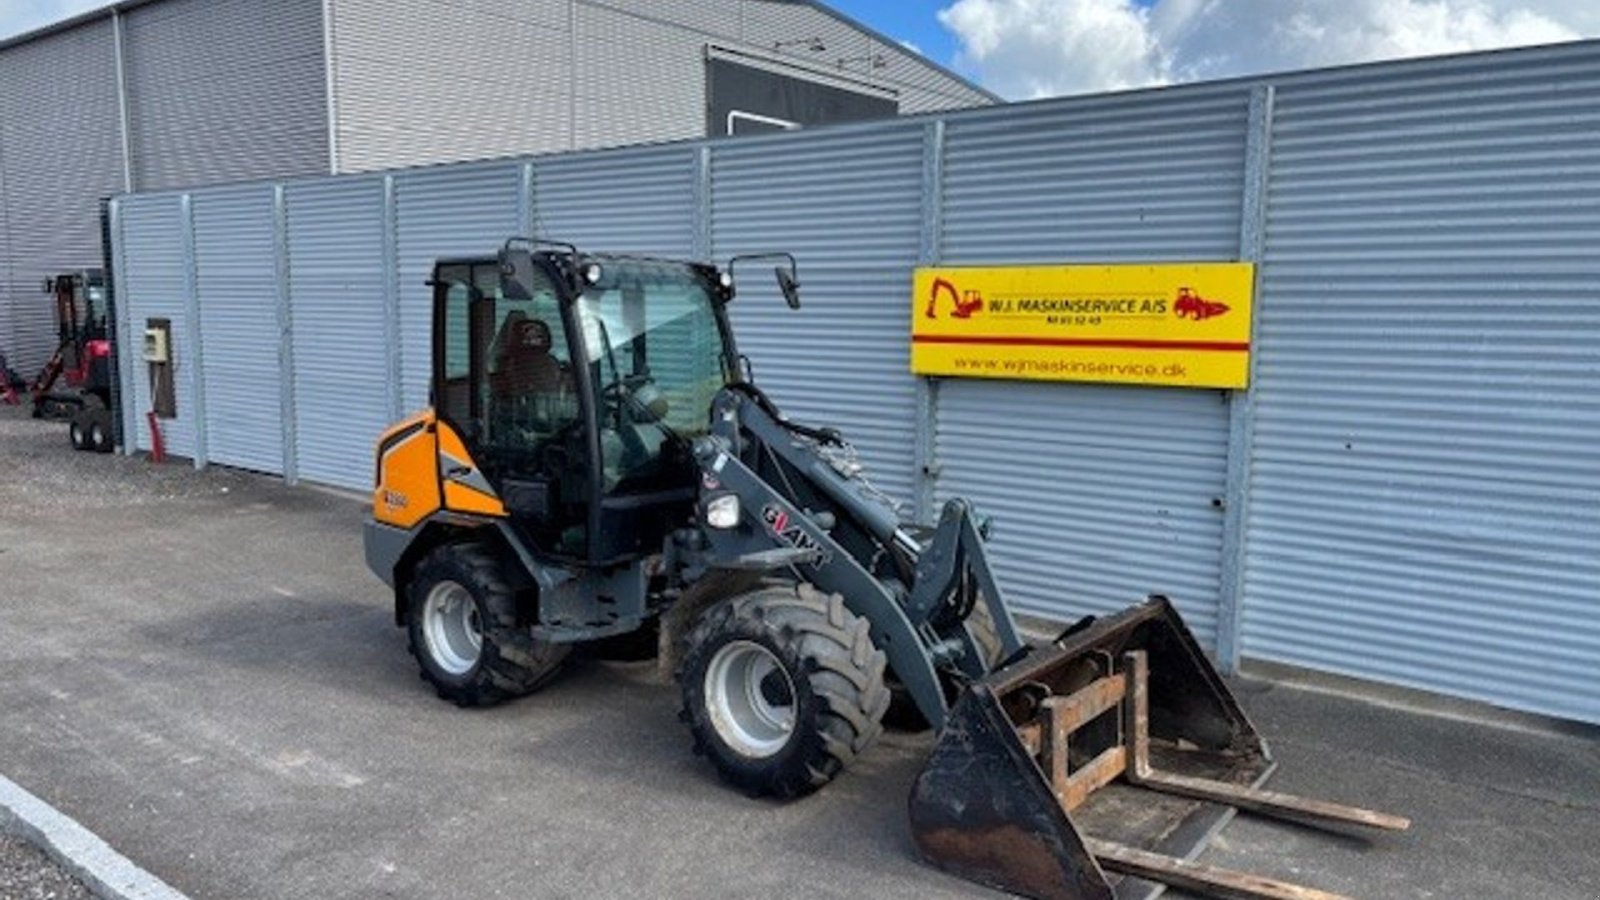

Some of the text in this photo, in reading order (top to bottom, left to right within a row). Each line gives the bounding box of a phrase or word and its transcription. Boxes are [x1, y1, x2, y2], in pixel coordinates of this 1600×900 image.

[1017, 299, 1137, 314] MASKINSERVICE
[1140, 300, 1167, 314] A/S
[954, 357, 1187, 378] www.wjmaskinservice.dk
